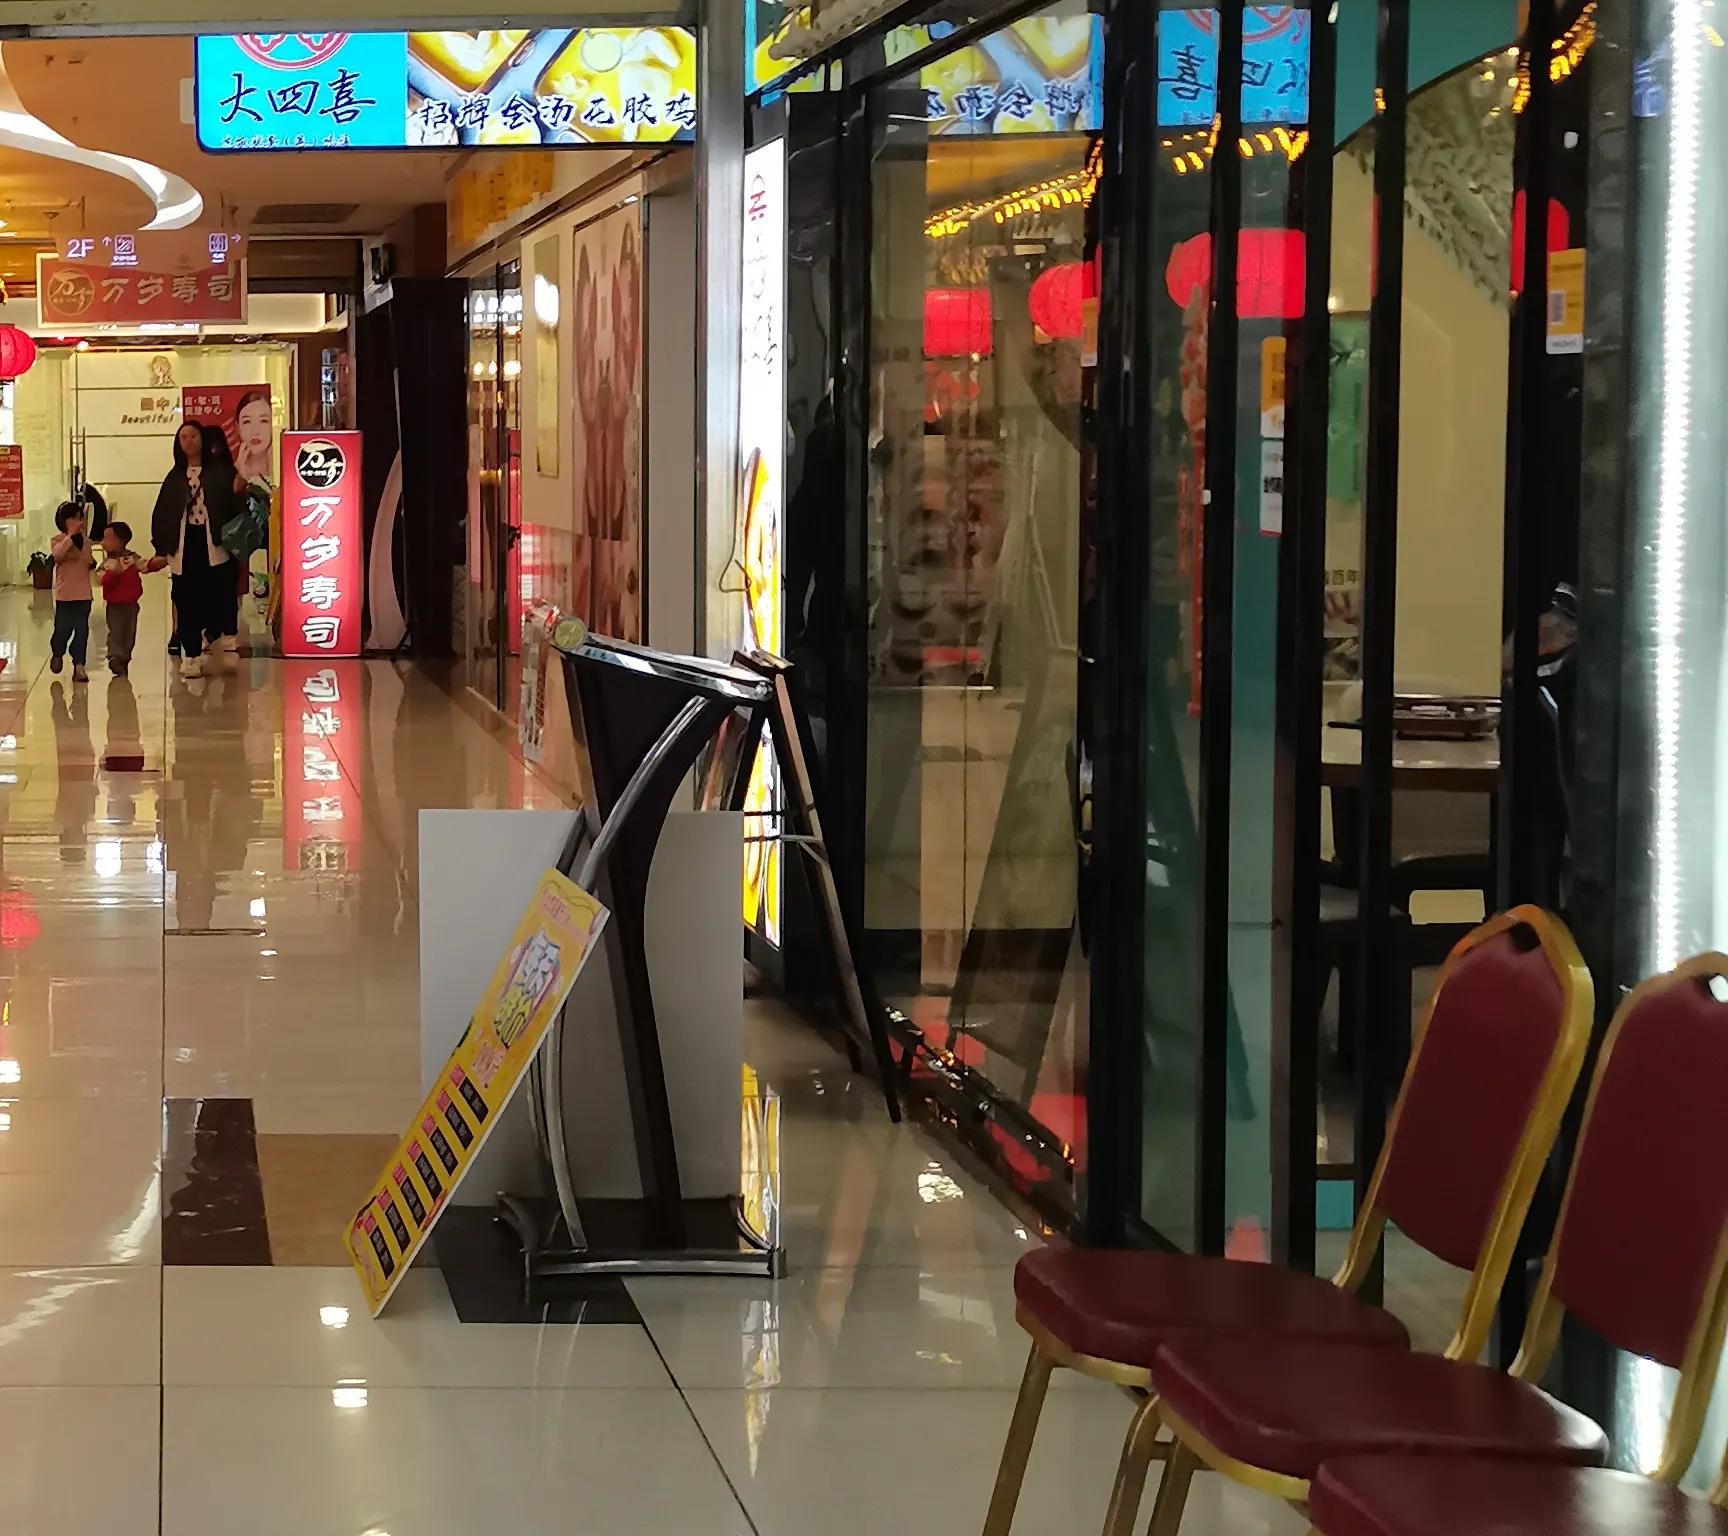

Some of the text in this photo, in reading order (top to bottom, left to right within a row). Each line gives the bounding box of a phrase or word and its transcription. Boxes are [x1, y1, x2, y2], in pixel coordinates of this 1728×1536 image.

[218, 68, 376, 126] 大四喜
[67, 239, 95, 258] 2F
[101, 276, 235, 304] 万岁寿司
[299, 495, 343, 649] 万岁寿司
